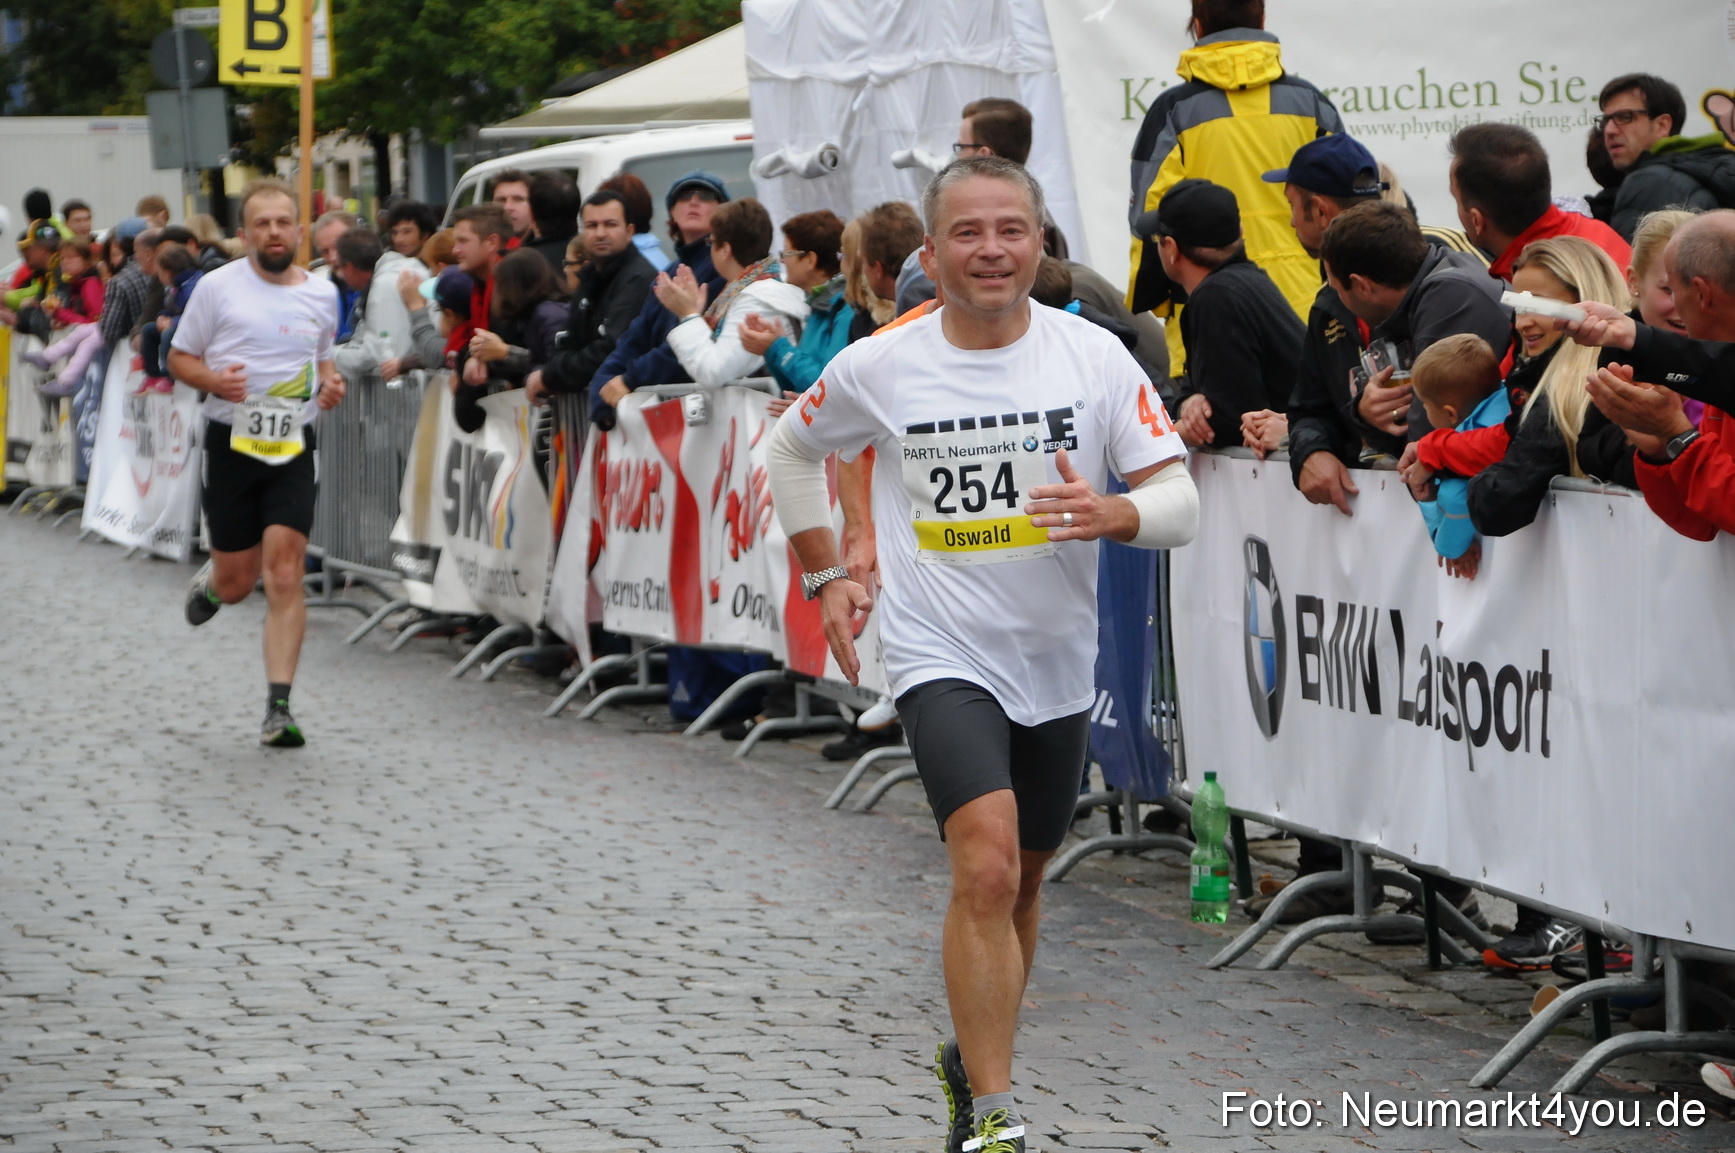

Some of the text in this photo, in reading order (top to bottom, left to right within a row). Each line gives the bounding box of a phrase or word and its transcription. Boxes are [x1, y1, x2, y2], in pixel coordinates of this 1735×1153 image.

[245, 0, 289, 51] B
[1519, 61, 1599, 104] Sie.
[248, 410, 292, 438] 316
[1138, 384, 1177, 438] 4
[903, 447, 945, 460] PARTL
[948, 440, 1017, 458] Neumarkt
[929, 460, 1020, 514] 254
[944, 523, 1011, 547] Oswald
[1296, 593, 1382, 716] BMW
